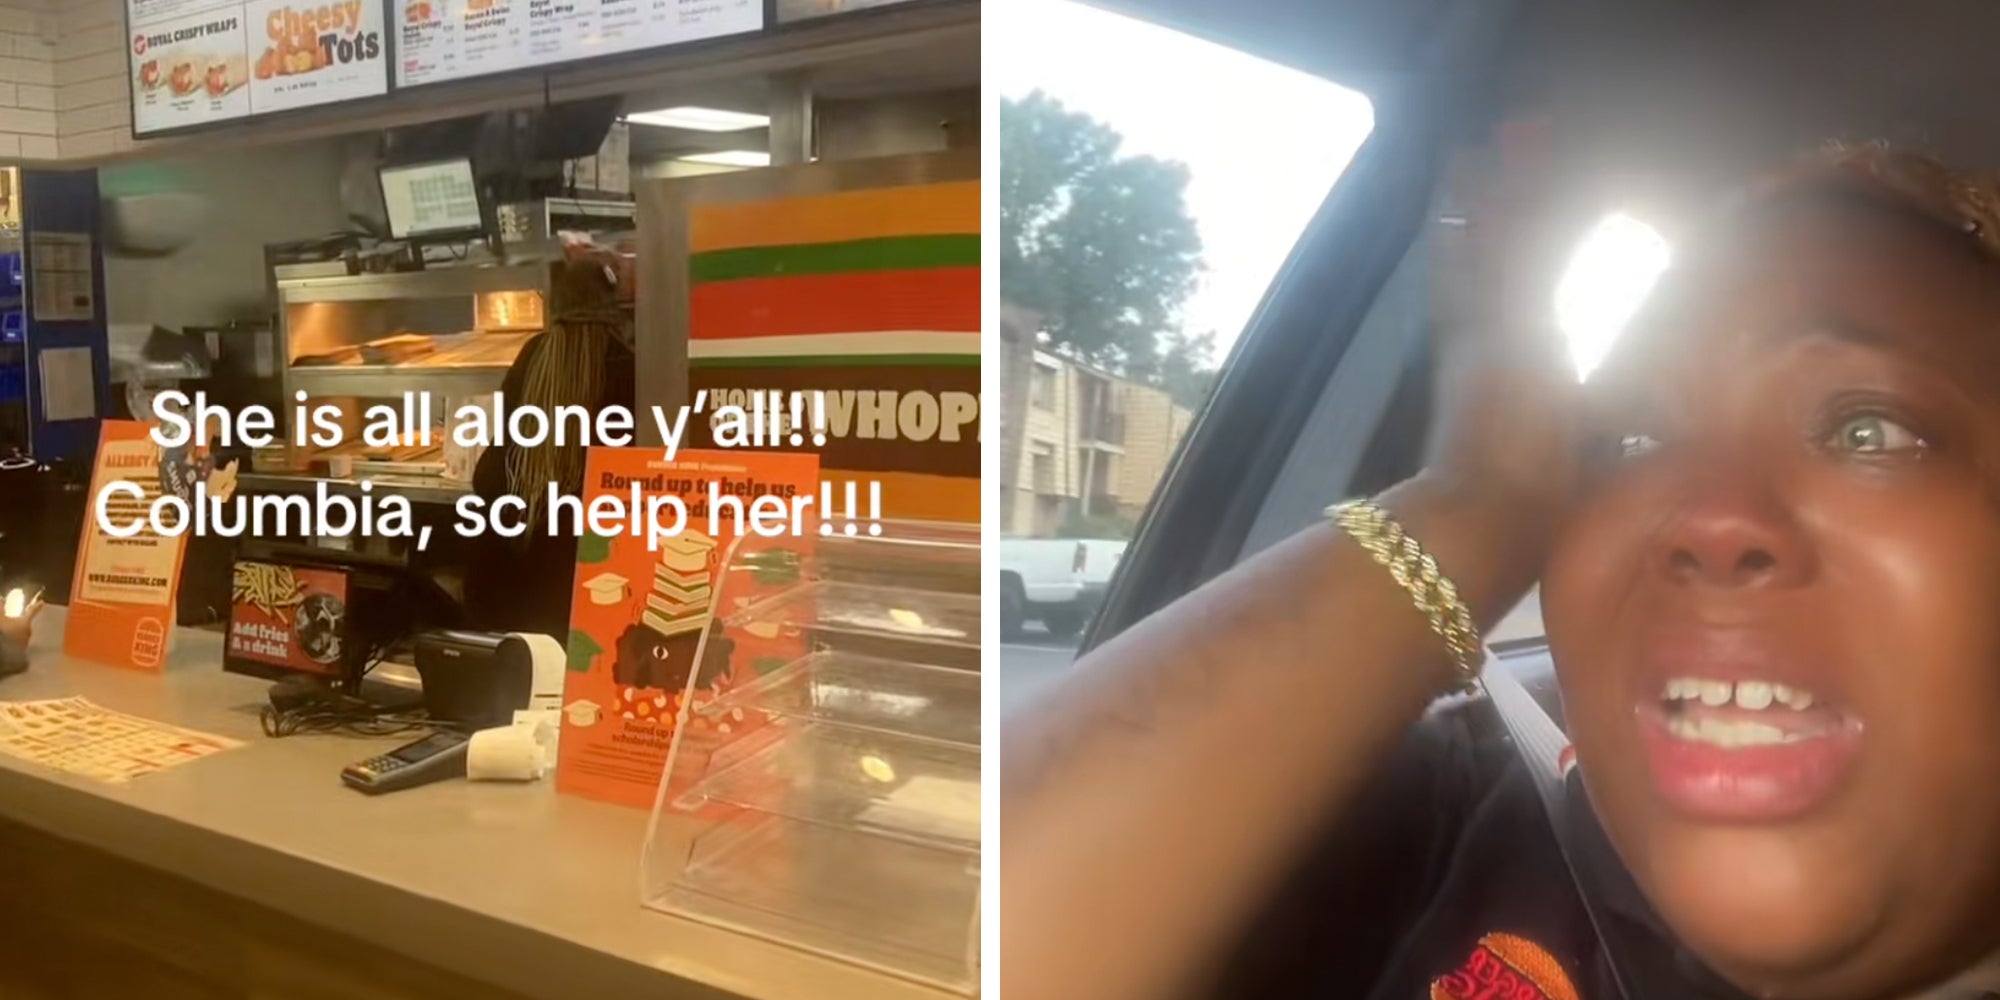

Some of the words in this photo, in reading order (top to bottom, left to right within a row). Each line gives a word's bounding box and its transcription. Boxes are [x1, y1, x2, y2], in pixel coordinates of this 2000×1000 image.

[147, 32, 173, 48] ROYAL
[174, 25, 205, 42] CRISPY
[205, 17, 237, 35] WRAPS
[266, 0, 361, 42] Cheesy
[319, 30, 379, 66] Tots
[801, 389, 981, 443] WHOP
[105, 454, 150, 468] ALLERGY
[666, 478, 692, 498] up
[720, 476, 767, 501] help
[770, 482, 796, 499] us
[232, 621, 258, 637] Add
[259, 623, 289, 643] fries
[252, 639, 288, 658] drink
